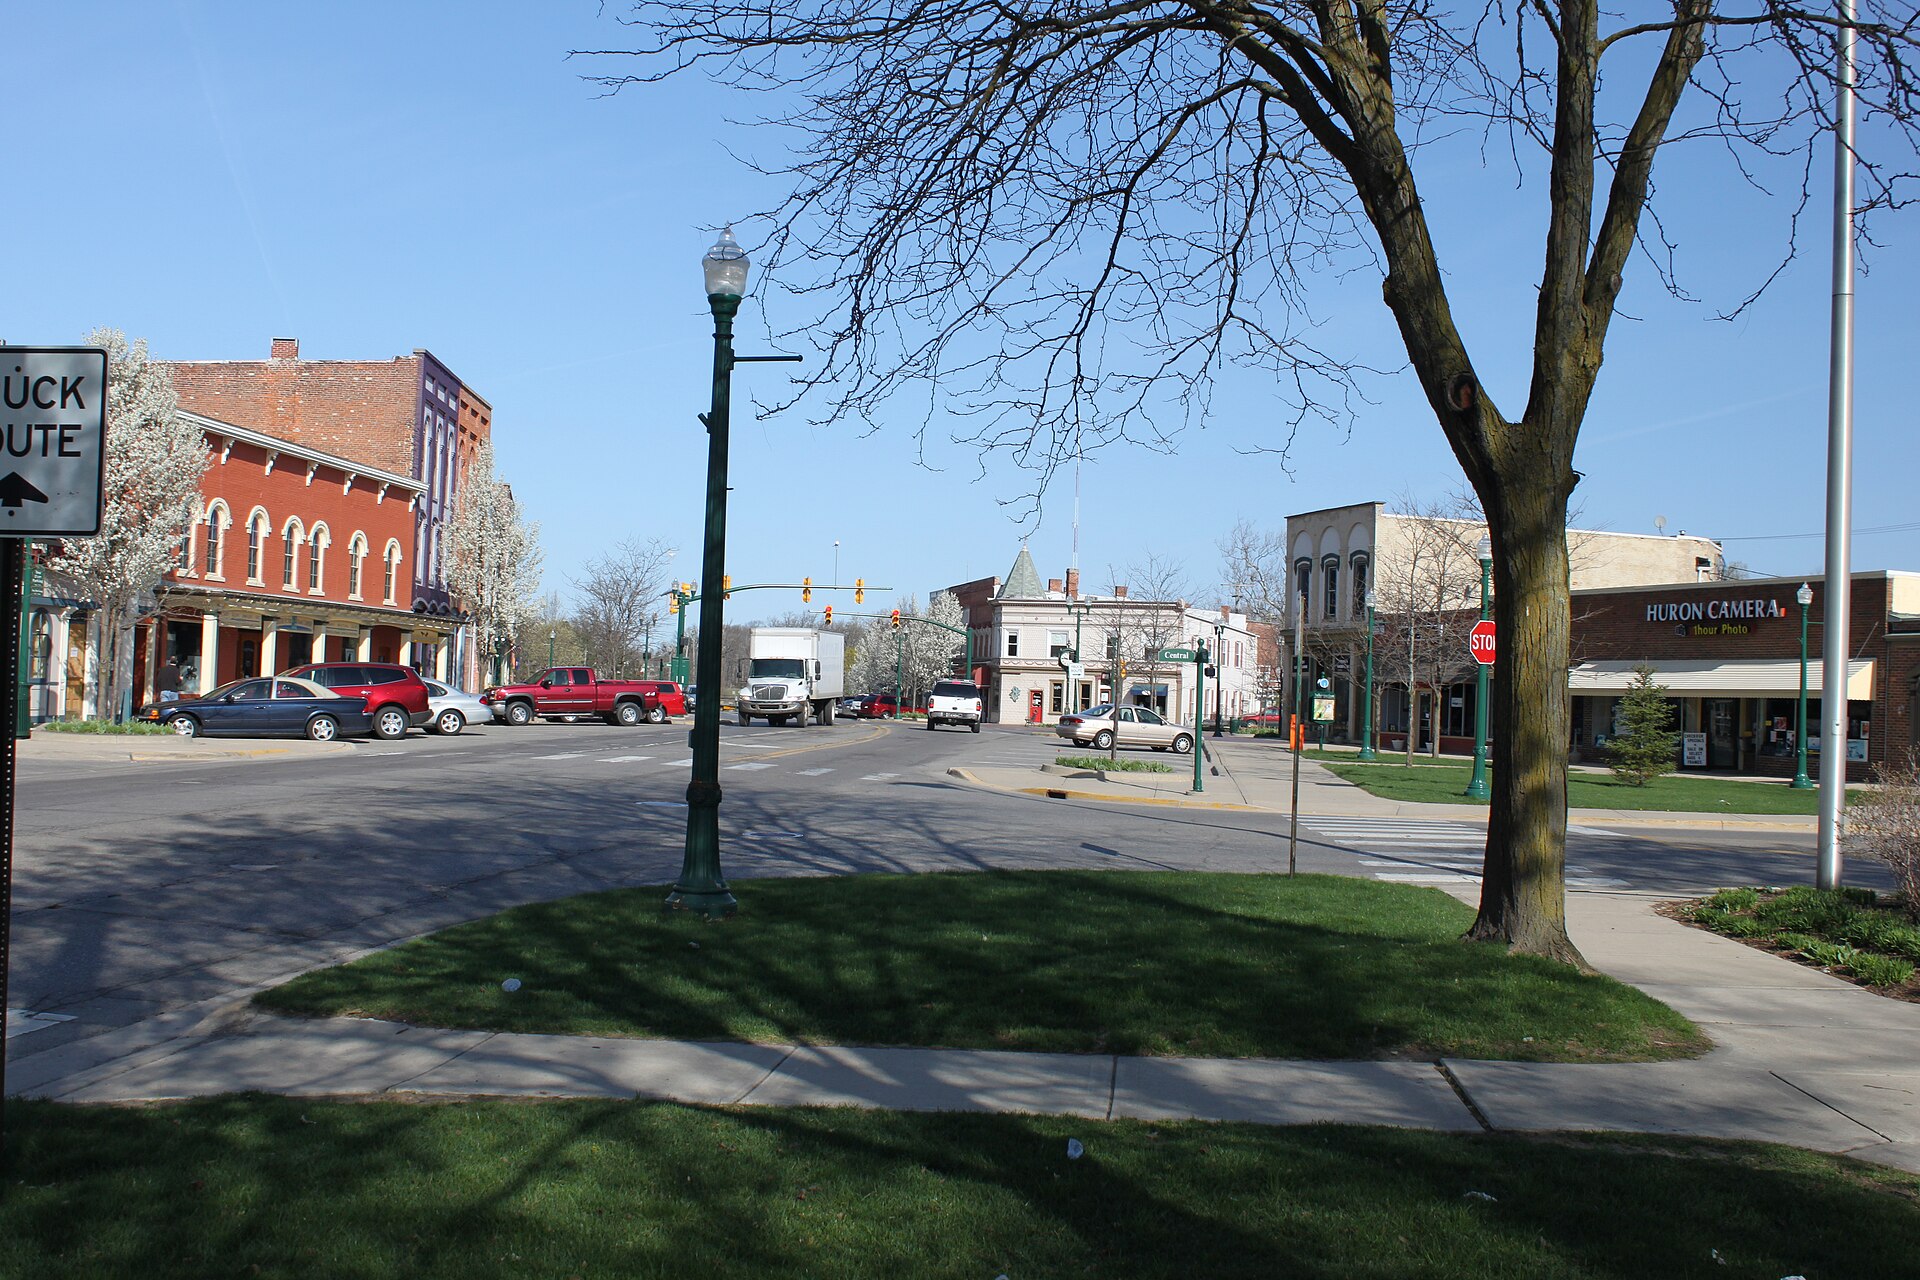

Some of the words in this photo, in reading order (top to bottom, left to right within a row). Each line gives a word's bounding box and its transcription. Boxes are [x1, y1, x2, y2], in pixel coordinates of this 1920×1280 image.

[4, 376, 86, 409] UCK
[0, 424, 82, 457] UTE
[1646, 602, 1703, 621] HURON
[1707, 599, 1779, 619] CAMERA
[1694, 625, 1717, 635] 1hour
[1722, 624, 1748, 634] Photo
[1164, 651, 1189, 659] Central
